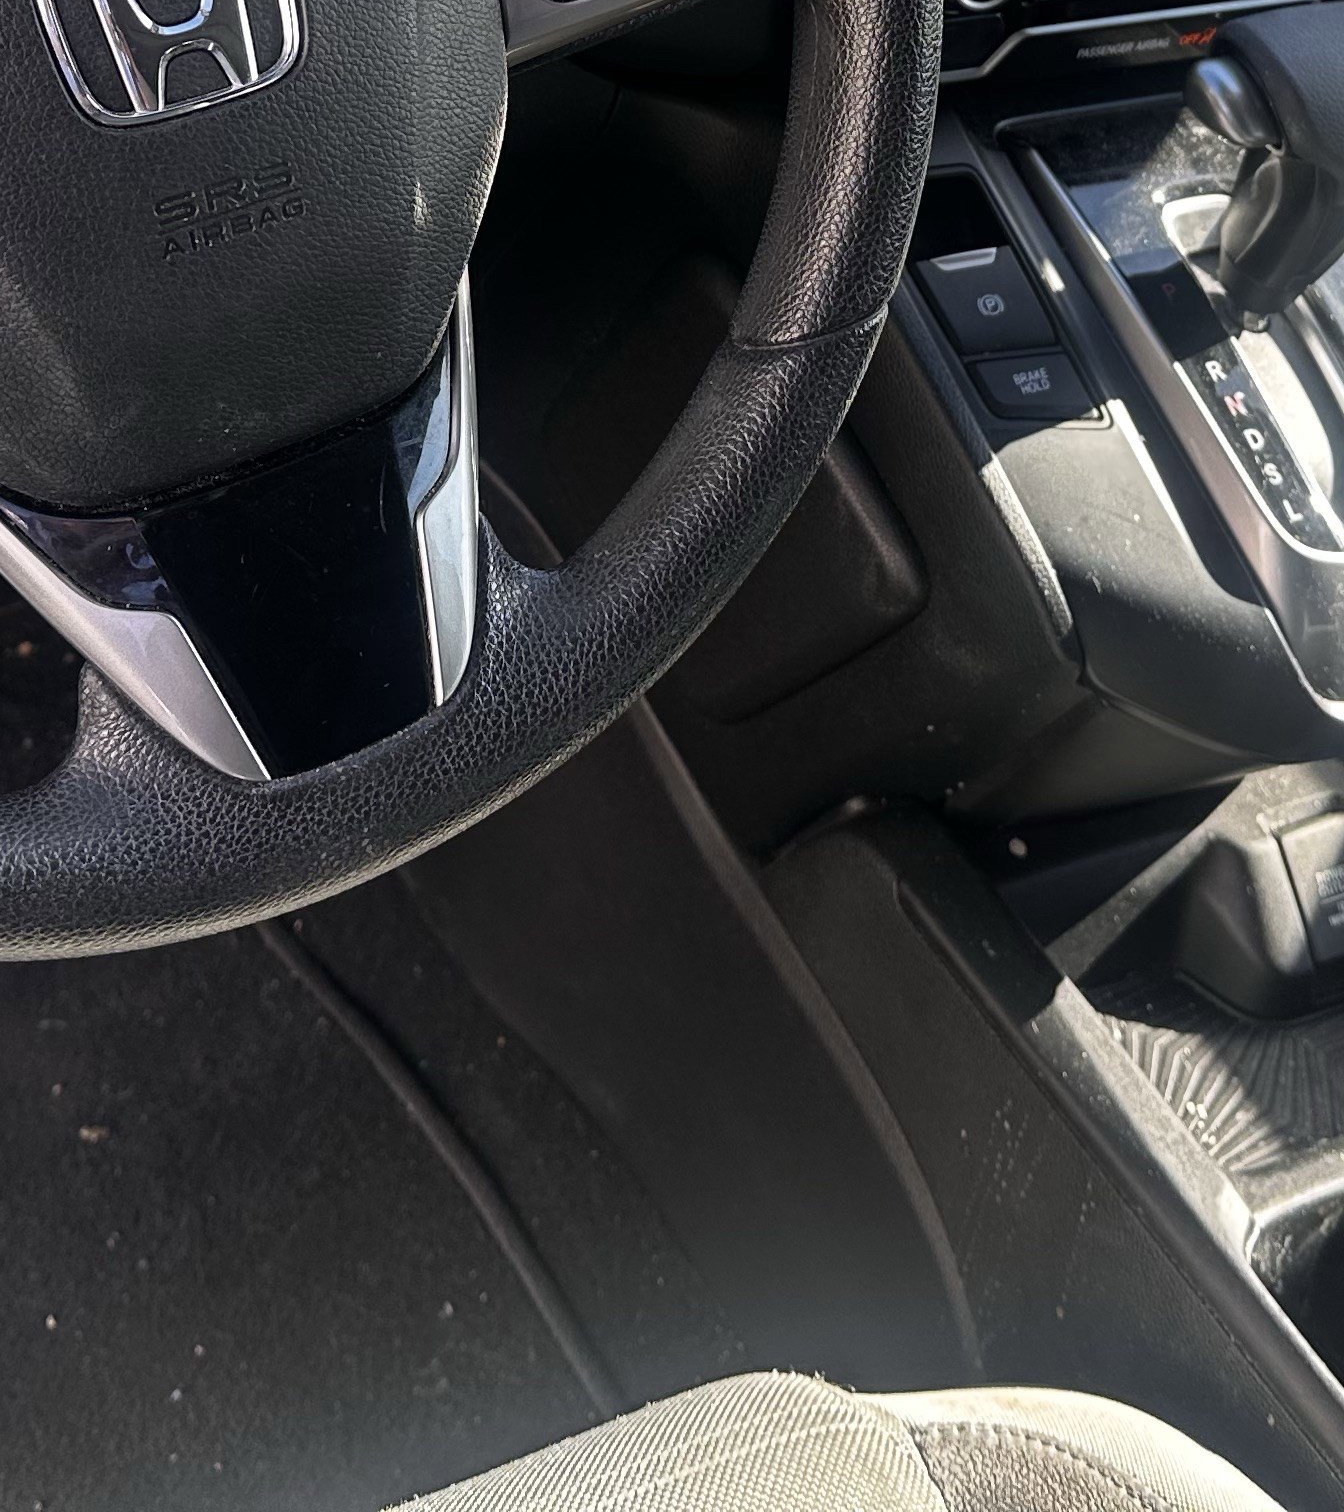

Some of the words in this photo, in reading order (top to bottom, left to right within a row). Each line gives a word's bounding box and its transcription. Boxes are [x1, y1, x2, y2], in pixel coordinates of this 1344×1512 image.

[152, 162, 296, 228] SRS
[162, 198, 308, 260] AIRBAG
[1012, 367, 1049, 385] BRAKE
[1205, 360, 1228, 382] R
[1020, 377, 1050, 395] HOLD
[1224, 391, 1248, 417] N
[1242, 428, 1265, 451] D
[1263, 462, 1284, 486] S
[1282, 499, 1304, 523] L
